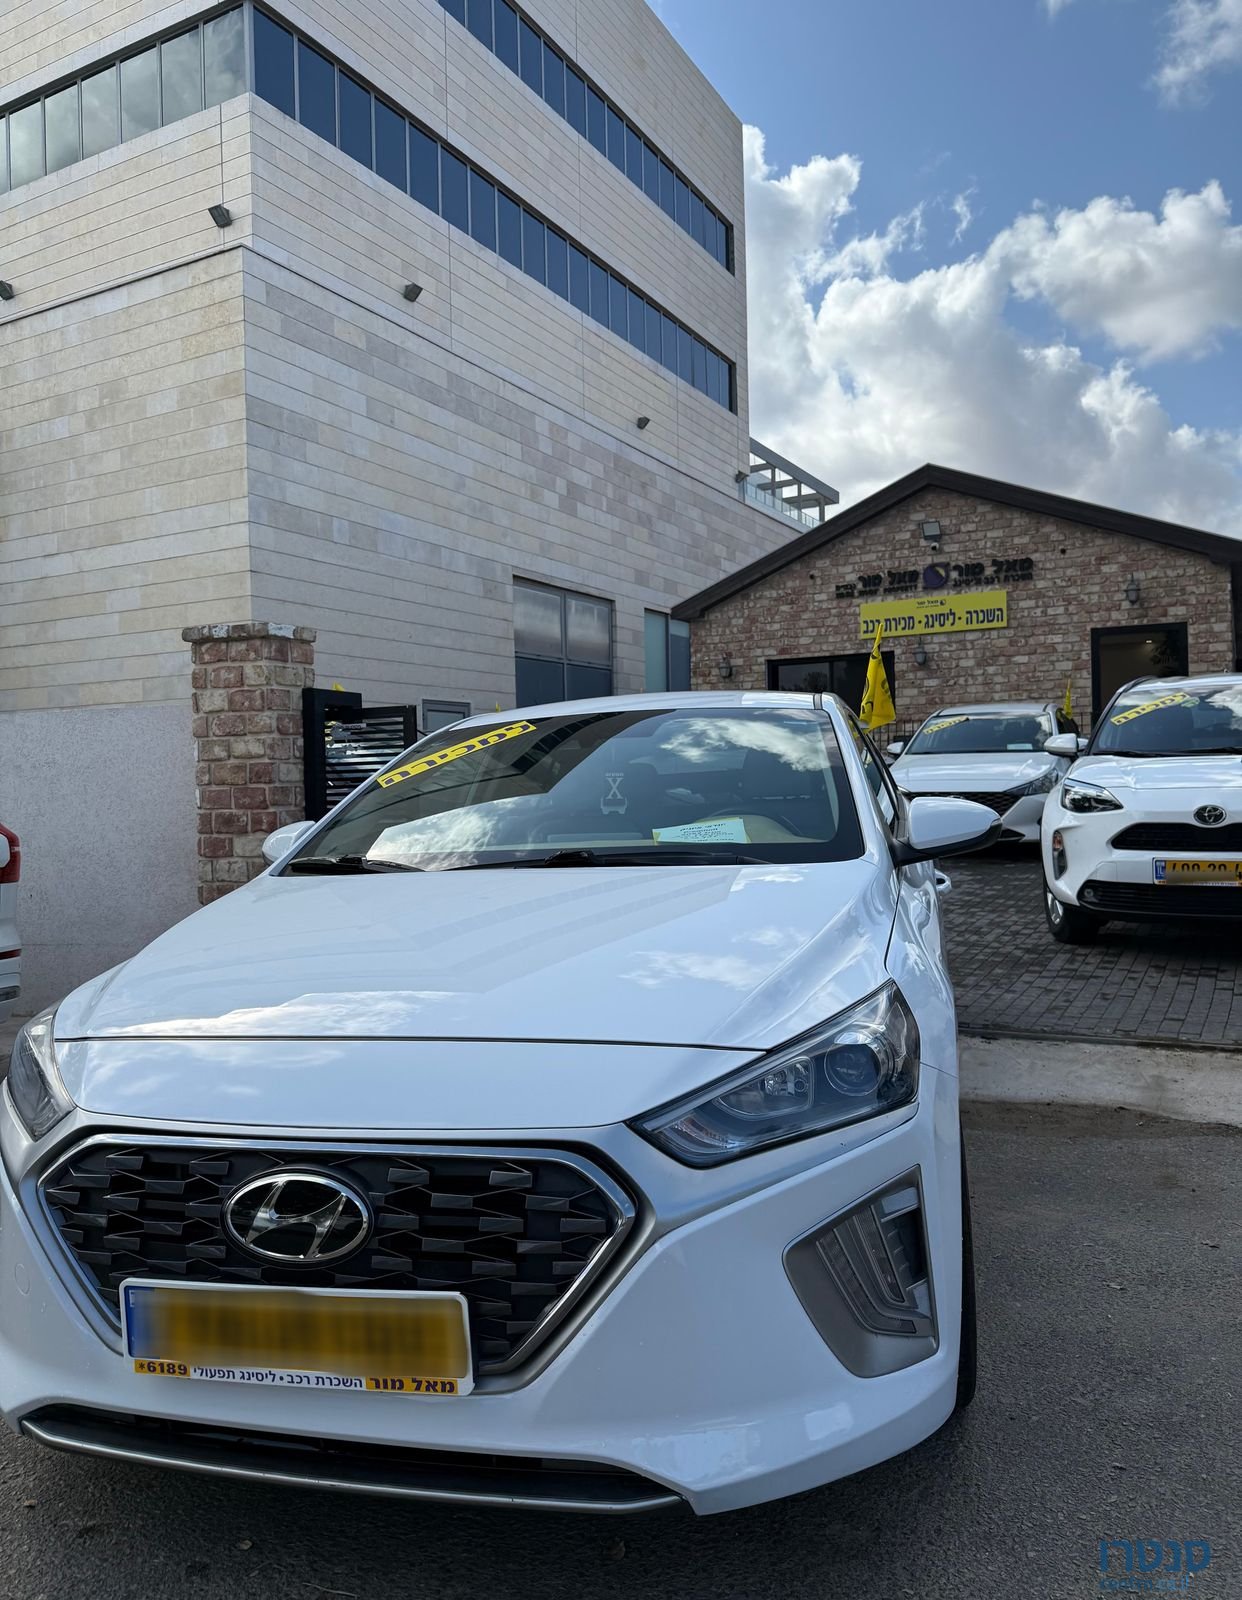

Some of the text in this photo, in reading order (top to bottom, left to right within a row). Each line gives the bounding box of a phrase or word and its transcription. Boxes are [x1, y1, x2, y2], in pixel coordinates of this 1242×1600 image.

[924, 608, 956, 629] ליסינג
[966, 607, 1004, 625] השכרה
[884, 616, 915, 633] מכירת
[381, 724, 532, 786] למכירה
[193, 1366, 236, 1380] תפעולי
[240, 1370, 276, 1383] ליסינג
[287, 1374, 311, 1385] רכב
[315, 1375, 363, 1388] השכרת
[369, 1377, 405, 1391] מור
[411, 1377, 455, 1393] מאל
